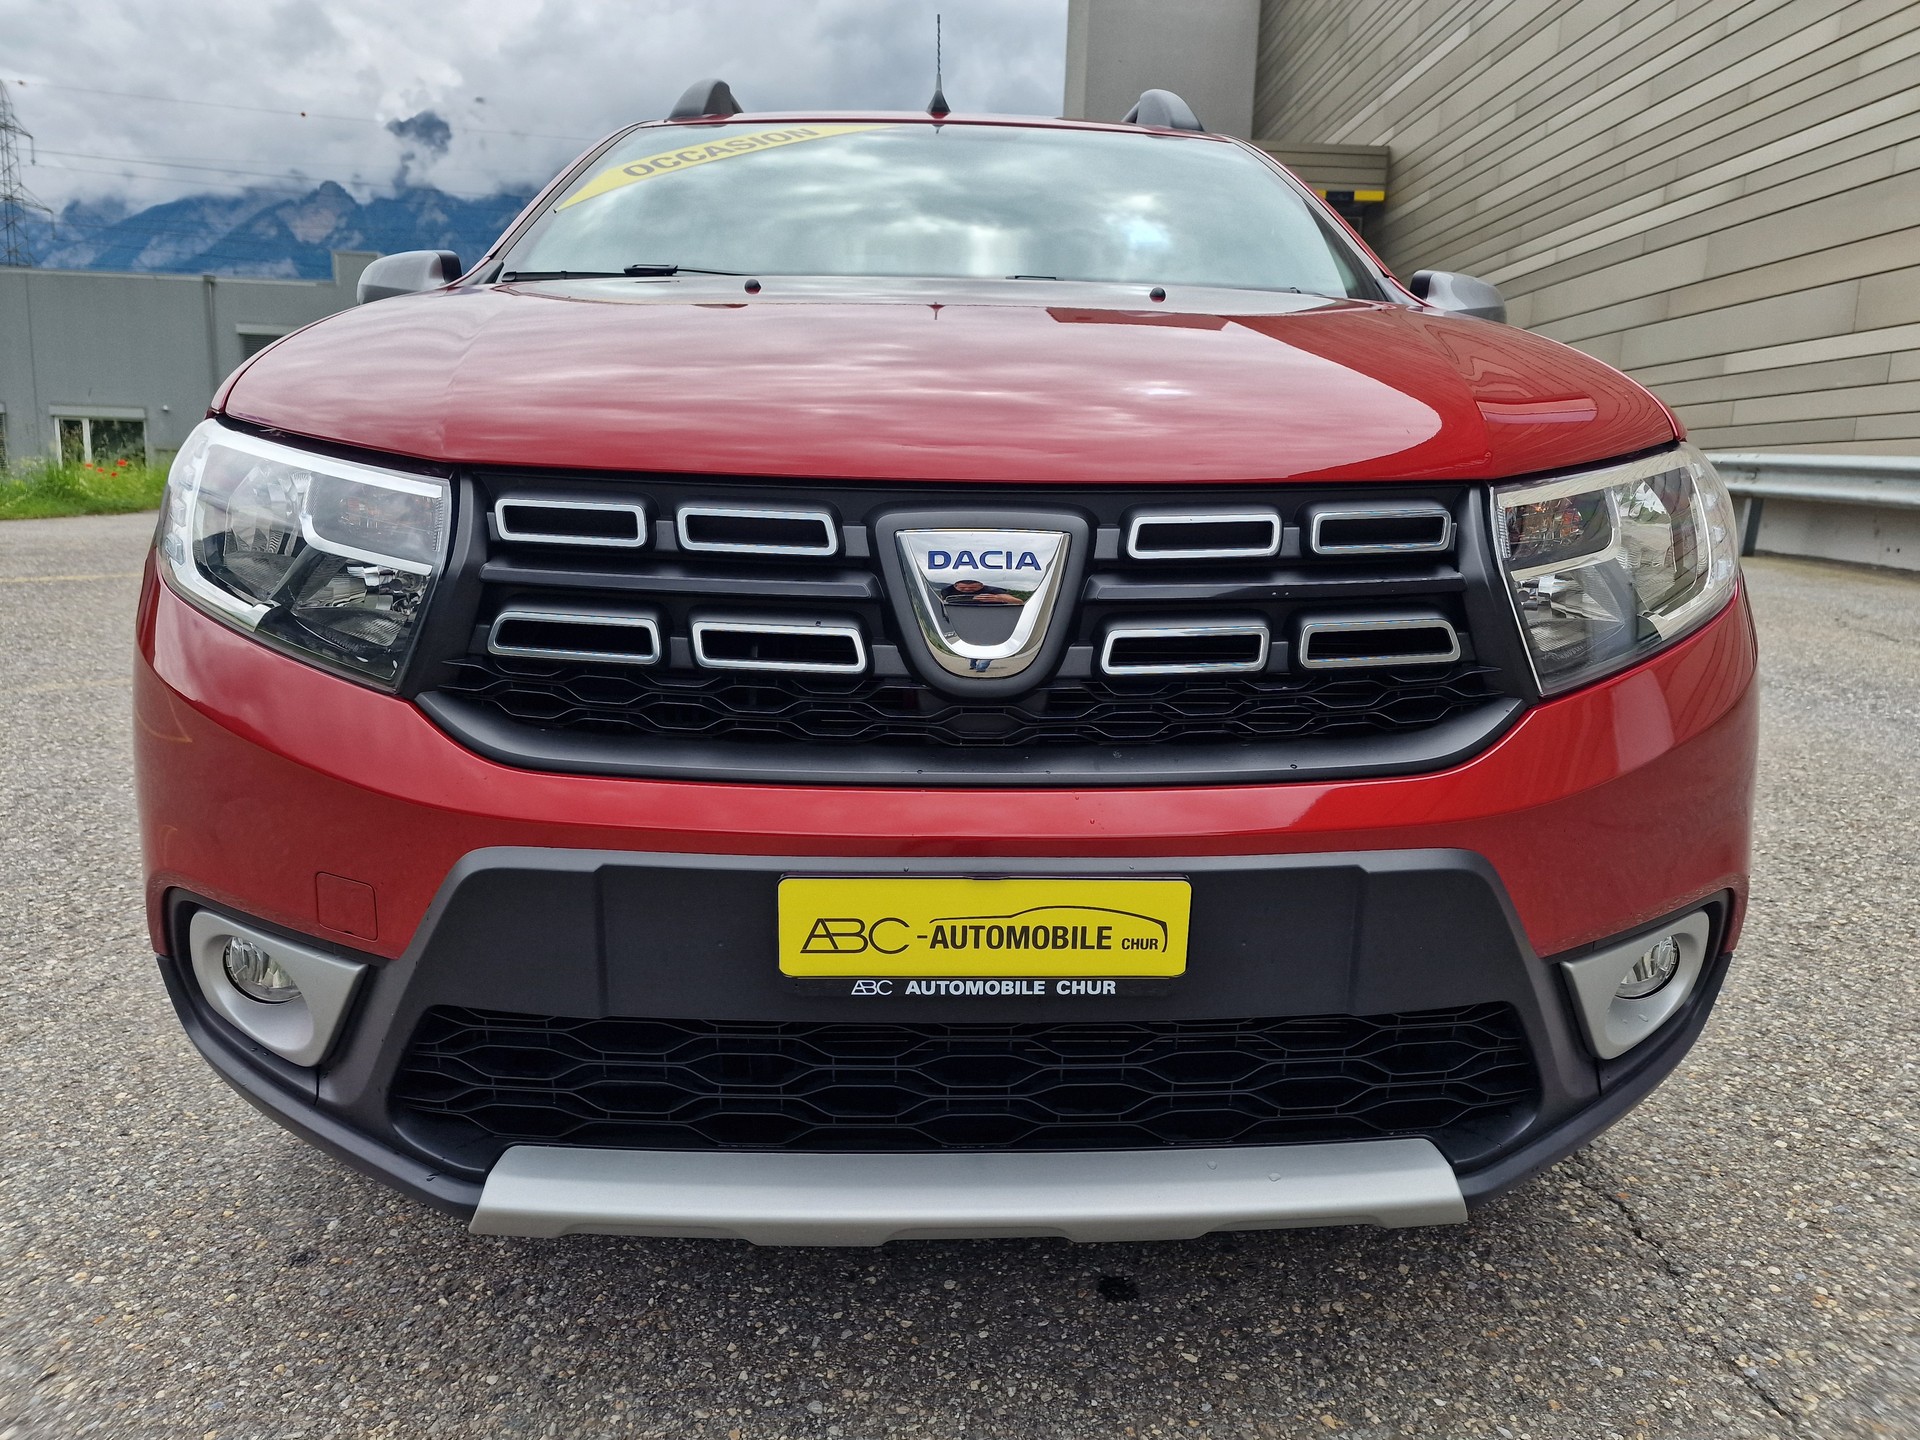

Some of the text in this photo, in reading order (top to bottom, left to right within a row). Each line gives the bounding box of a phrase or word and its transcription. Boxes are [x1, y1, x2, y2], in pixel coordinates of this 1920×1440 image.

[622, 128, 820, 177] OCCASION
[928, 550, 1042, 570] DACIA
[1121, 937, 1159, 951] CHUR
[850, 979, 1117, 996] ABC AUTOMOBILE CHUR
